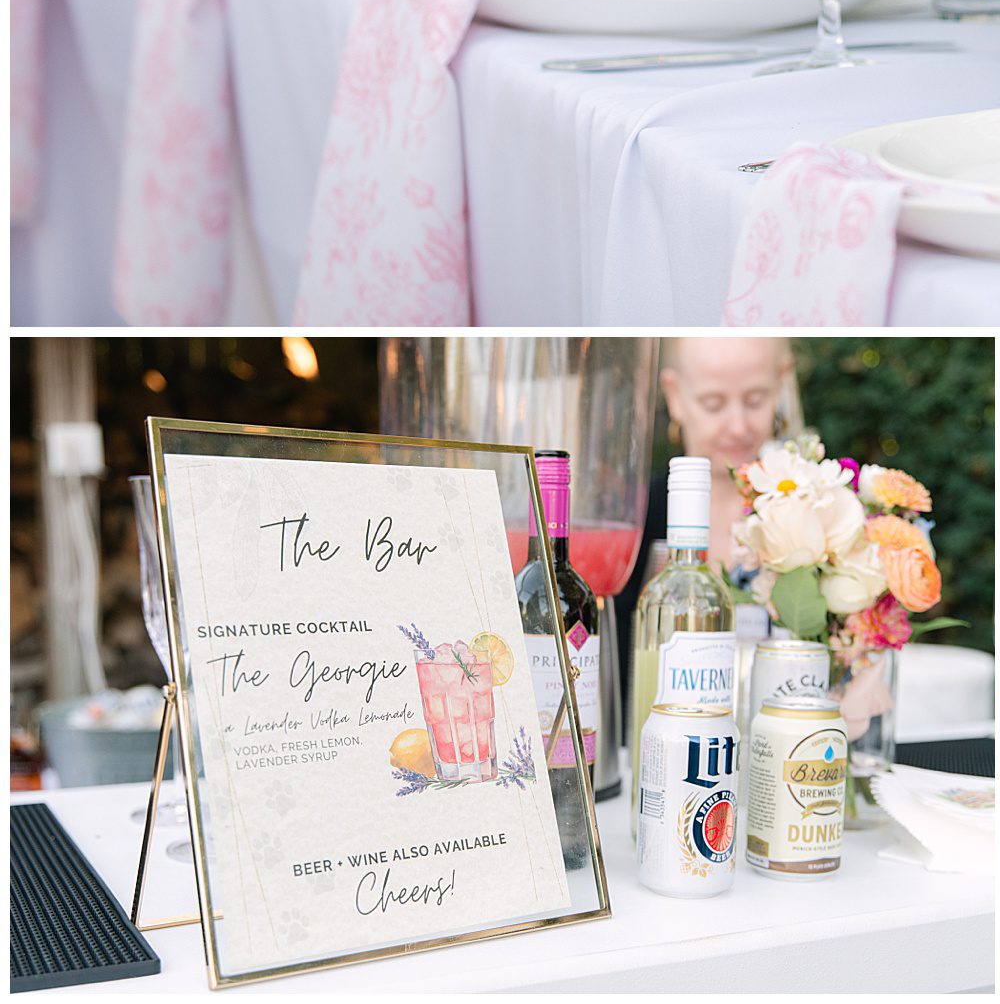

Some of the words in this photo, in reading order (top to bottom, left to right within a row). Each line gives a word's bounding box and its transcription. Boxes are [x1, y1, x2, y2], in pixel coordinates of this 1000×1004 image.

[260, 513, 340, 571] The
[365, 517, 437, 572] Bar
[197, 623, 292, 638] SIGNATURE
[296, 621, 372, 635] COCKTAIL
[206, 649, 270, 696] The
[289, 651, 407, 703] Georgie
[224, 725, 235, 734] a
[244, 712, 303, 736] Lavender
[310, 709, 350, 730] Vodka
[358, 703, 415, 726] Lemonade
[281, 740, 317, 752] FRESH
[236, 755, 298, 770] LAVENDER
[301, 750, 338, 763] SYRUP
[800, 787, 837, 798] BREWING
[699, 794, 720, 815] FINE
[695, 816, 704, 824] A
[293, 859, 333, 877] BEER
[347, 851, 388, 868] WINE
[393, 845, 429, 861] ALSO
[434, 833, 507, 855] AVAILABLE
[355, 868, 456, 916] Cheers!
